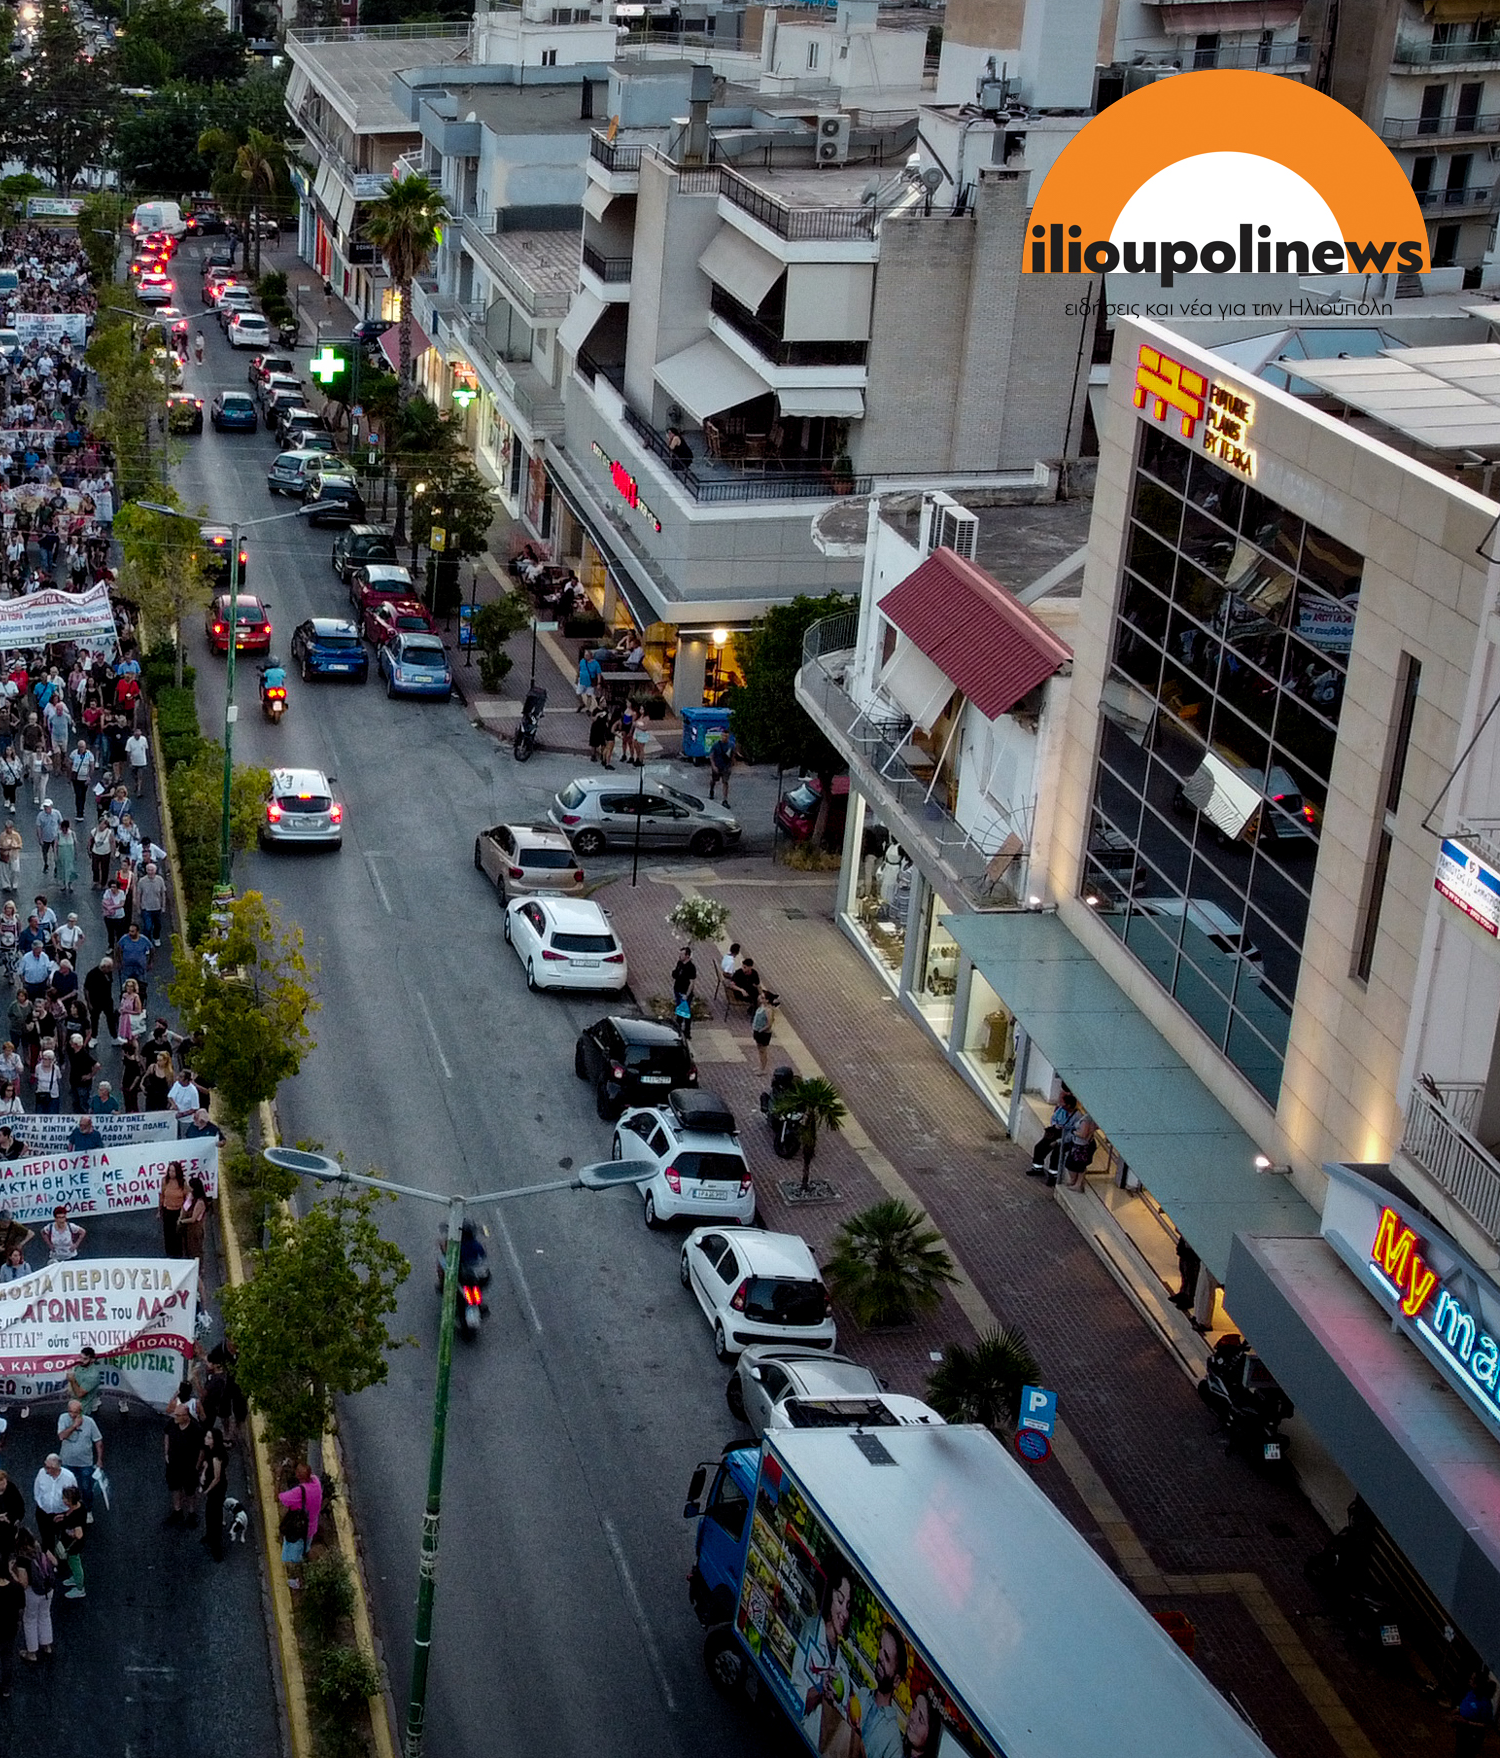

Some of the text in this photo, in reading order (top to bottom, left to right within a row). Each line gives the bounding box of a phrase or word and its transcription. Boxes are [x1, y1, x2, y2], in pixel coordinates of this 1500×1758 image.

[1203, 428, 1219, 454] BY
[95, 1115, 114, 1123] ΤΟΥΣ
[102, 1124, 124, 1132] ΛΑΟΥ
[23, 1153, 110, 1177] ΠΕΡΙΟΥΣΙΑ
[102, 1169, 124, 1183] ΜΕ
[56, 1188, 91, 1202] ΟΥΤΕ
[61, 1268, 173, 1292] ΠΕΡΙΟΥΣΙΑ
[21, 1297, 108, 1323] ΑΓΩΝΕΣ
[111, 1307, 132, 1320] του
[136, 1290, 190, 1321] ΛΑΟΥ
[1371, 1206, 1500, 1401] My ma
[48, 1333, 69, 1348] ούτε
[11, 1361, 37, 1371] ΚΑΙ
[136, 1338, 185, 1351] ΠΟΛΗΣ
[21, 1385, 32, 1395] το
[1029, 1391, 1048, 1412] P
